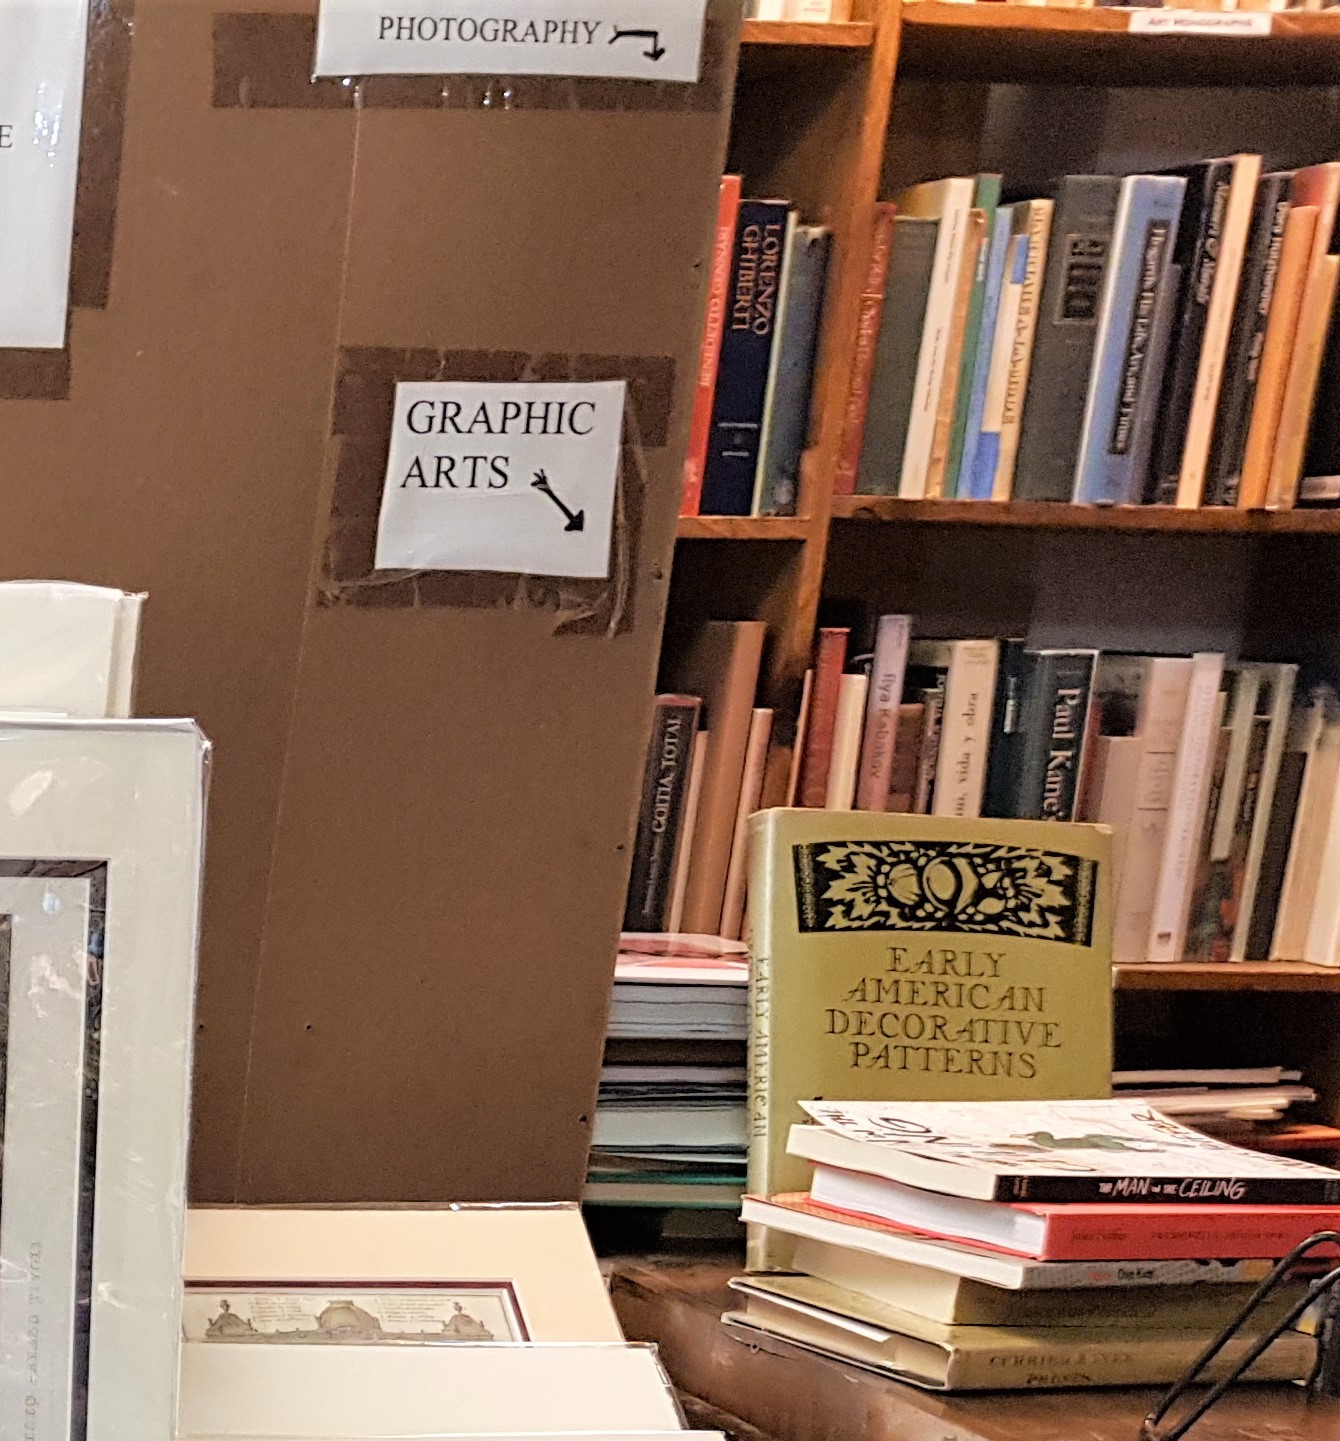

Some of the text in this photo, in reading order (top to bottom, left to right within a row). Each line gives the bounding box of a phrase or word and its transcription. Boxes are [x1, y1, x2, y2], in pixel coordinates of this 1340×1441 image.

[377, 15, 603, 46] PHOTOGRAPHY
[731, 224, 761, 331] GHIBERTI
[752, 224, 781, 336] LORENZO
[405, 398, 598, 437] GRAPHIC
[399, 453, 511, 490] ARTS
[962, 692, 978, 726] obra
[1051, 687, 1082, 739] Paul
[661, 715, 683, 768] TOTAL
[955, 752, 971, 784] vida
[887, 946, 1006, 978] EARLY
[842, 977, 1047, 1013] AMERICAN
[753, 957, 770, 1138] EARLY AMERICAN
[824, 1008, 1063, 1049] DECORATIVE
[849, 1041, 1038, 1079] PATTERNS
[1112, 1177, 1247, 1200] MAN CEILING
